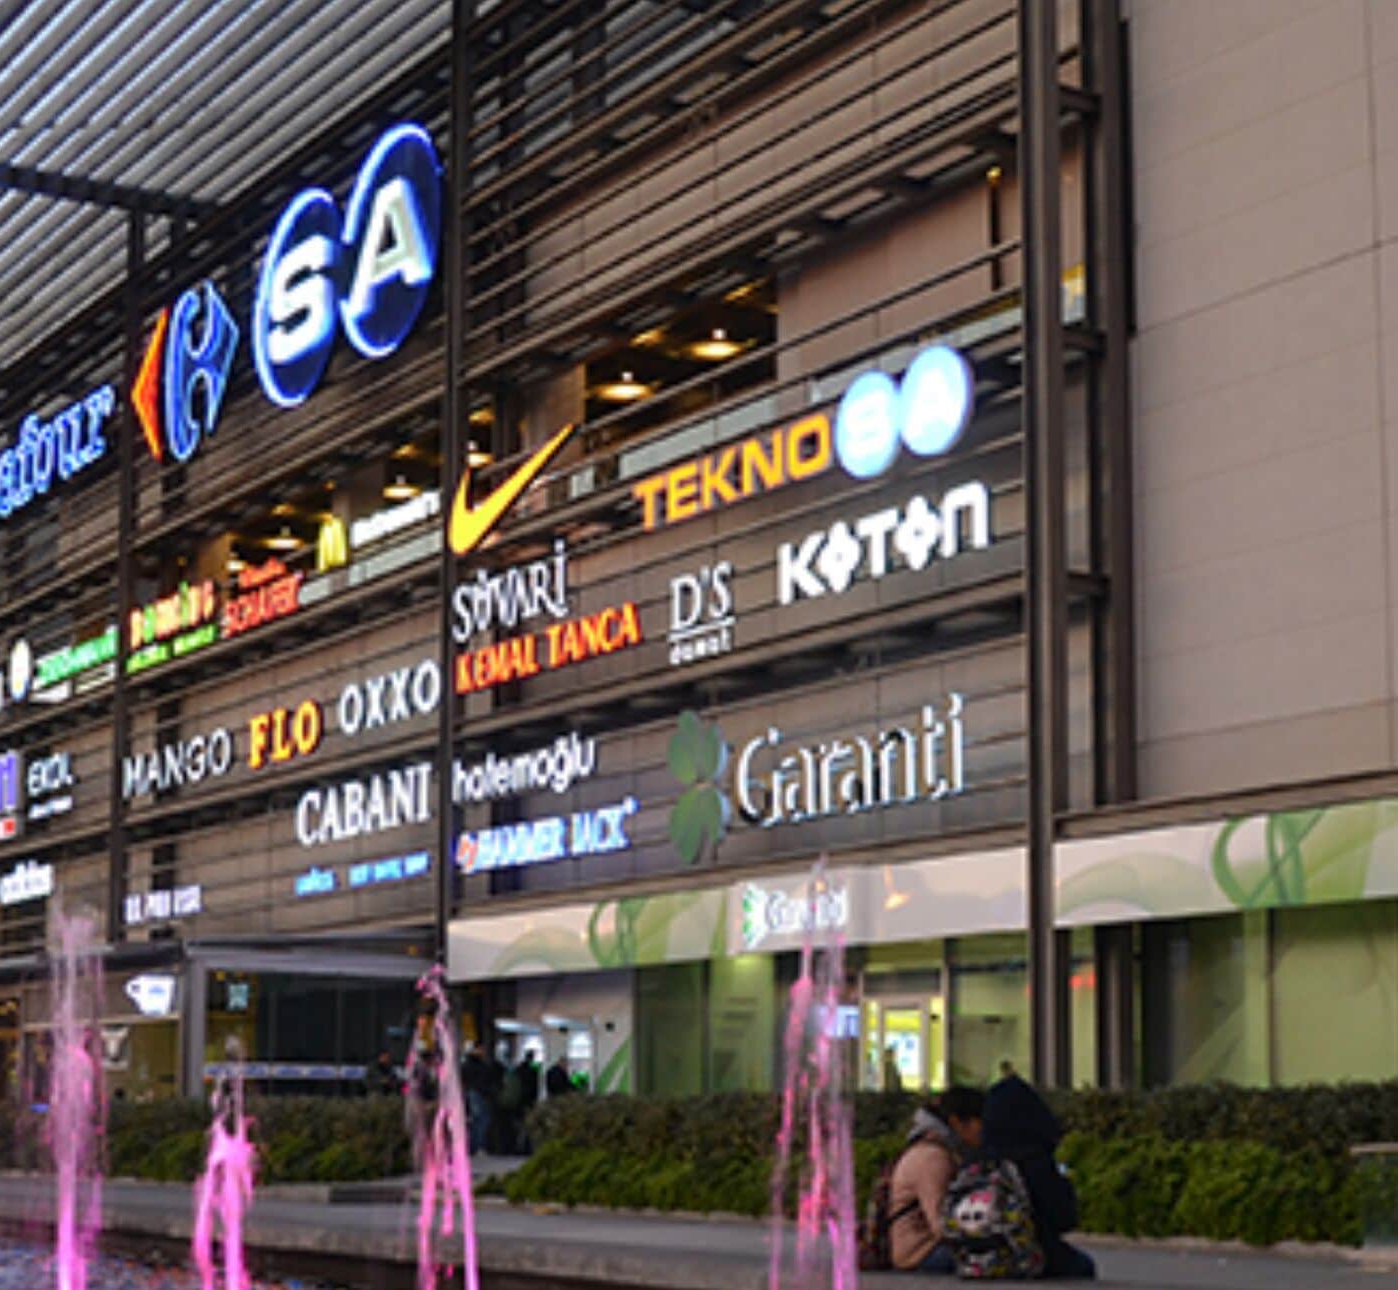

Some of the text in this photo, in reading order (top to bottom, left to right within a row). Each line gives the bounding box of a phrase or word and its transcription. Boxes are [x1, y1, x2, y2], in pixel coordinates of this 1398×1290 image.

[776, 479, 991, 605] KOTON
[454, 601, 641, 695] KEMAL TANCA
[123, 658, 441, 798] MANGO FLO OXXO
[735, 693, 966, 829] Garanti
[295, 762, 432, 846] CABANI
